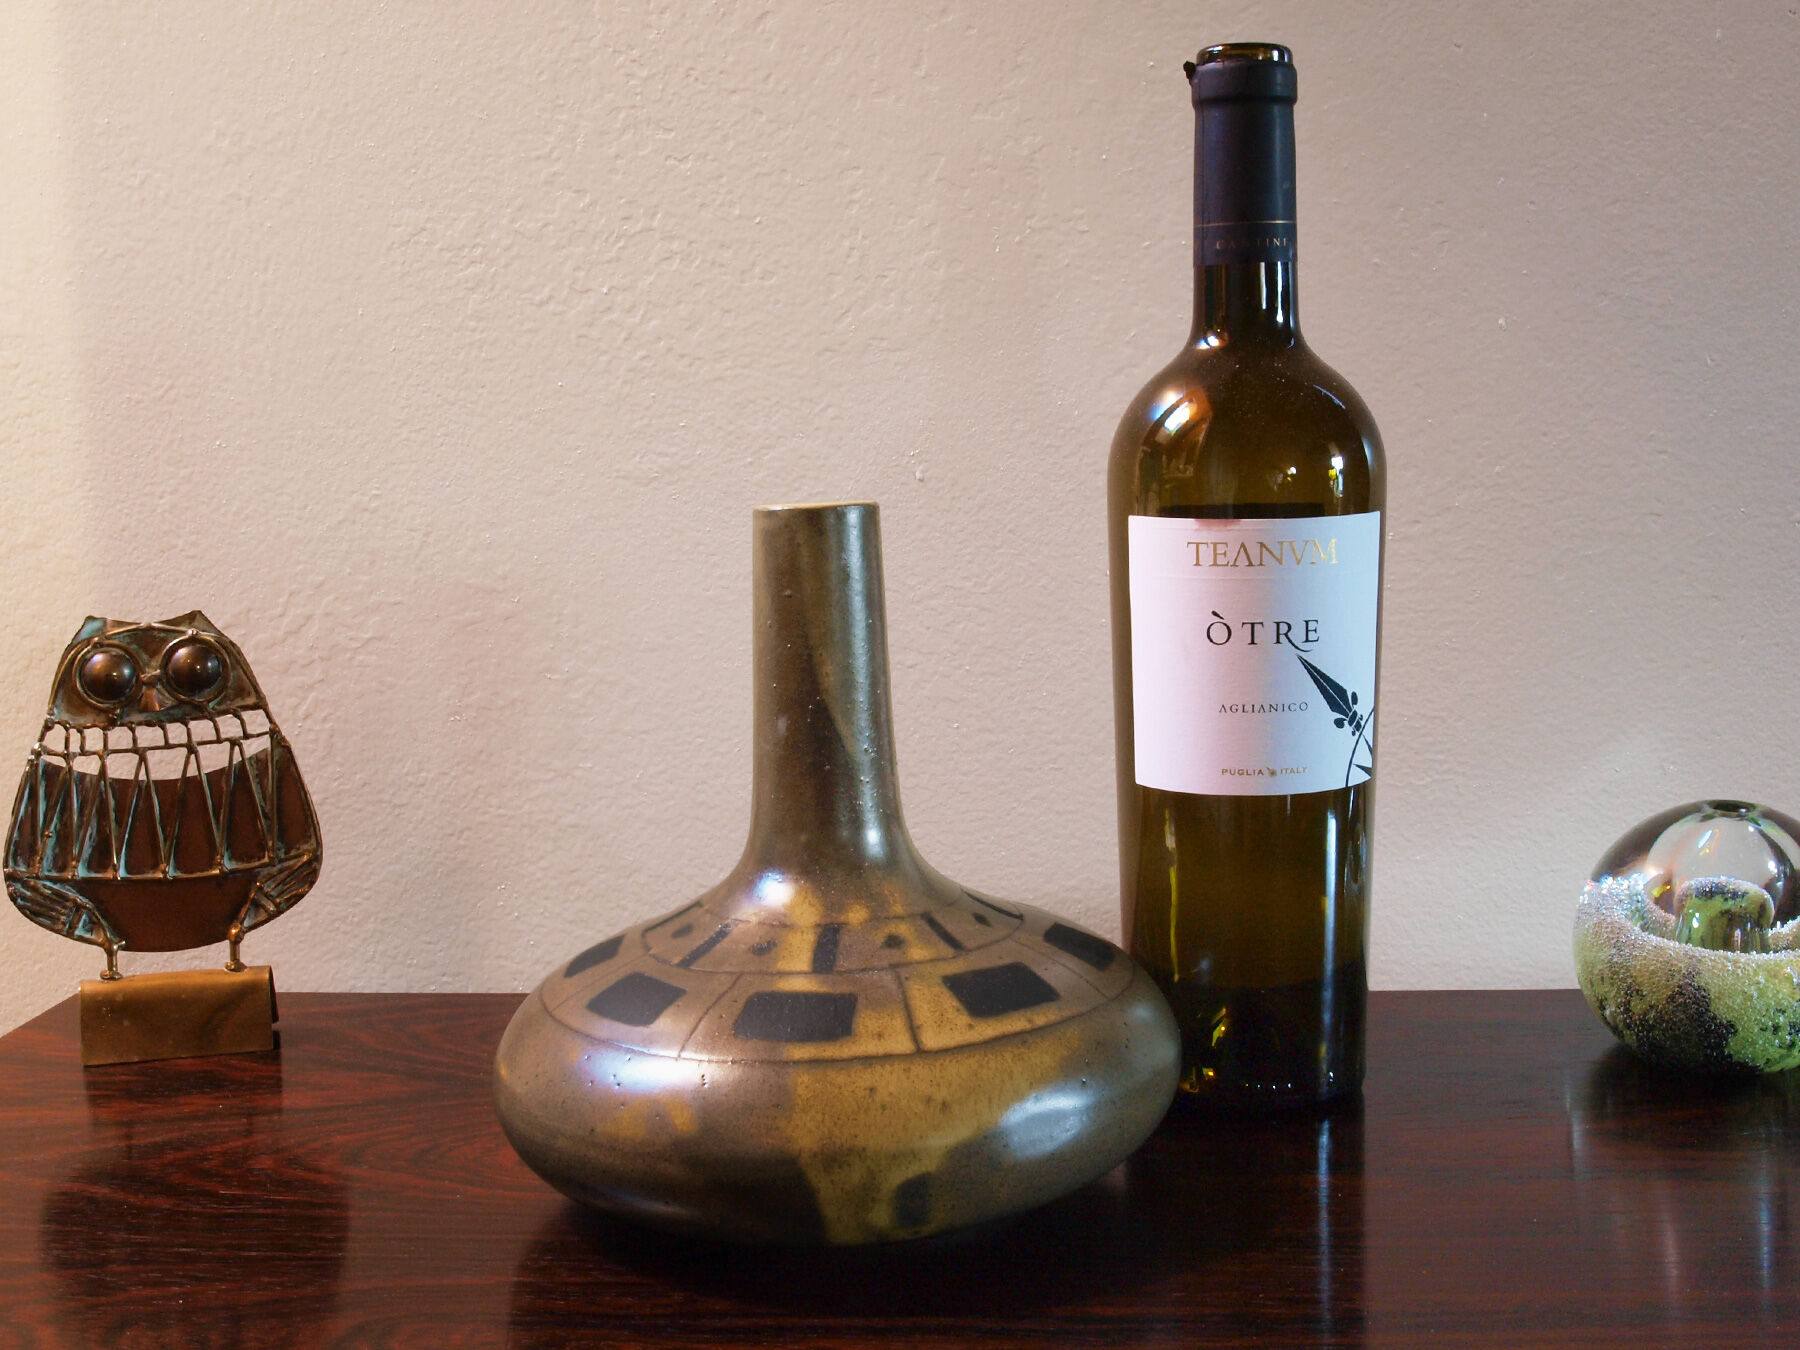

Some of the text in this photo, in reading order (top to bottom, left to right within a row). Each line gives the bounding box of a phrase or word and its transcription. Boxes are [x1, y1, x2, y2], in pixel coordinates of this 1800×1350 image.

[1215, 237, 1288, 250] CATIN
[1186, 538, 1339, 567] TEANVM
[1206, 610, 1320, 652] ÒTRE
[1218, 702, 1309, 714] AGLIANICO
[1221, 766, 1308, 777] PUGLIA ITALY
